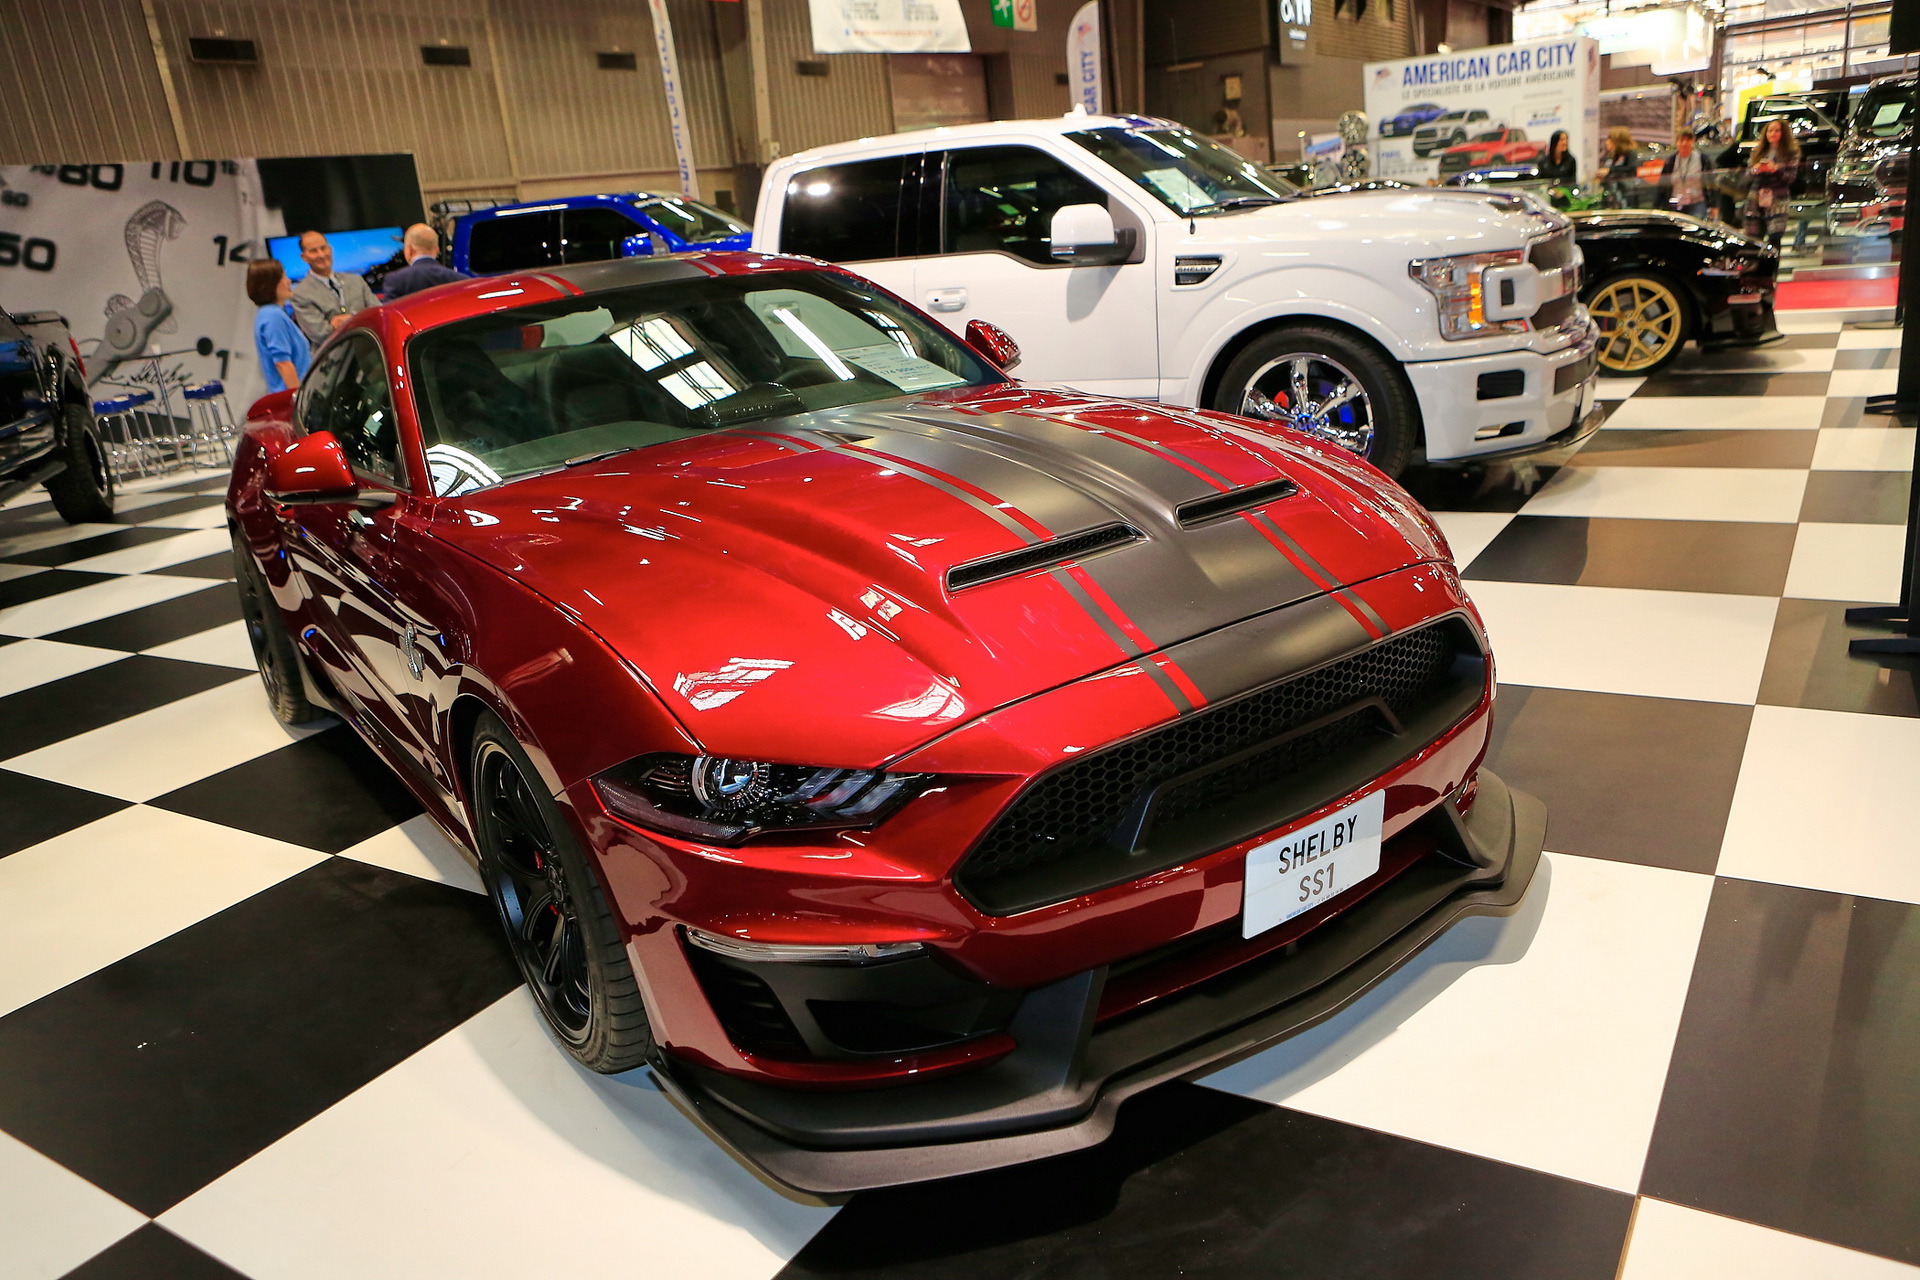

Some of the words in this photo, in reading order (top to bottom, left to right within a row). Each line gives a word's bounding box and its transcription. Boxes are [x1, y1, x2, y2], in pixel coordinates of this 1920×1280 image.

[1081, 51, 1096, 82] CITY
[1403, 57, 1490, 86] AMERICAN
[1497, 50, 1530, 75] CAR
[1537, 42, 1577, 69] CITY
[1083, 86, 1097, 115] CAR
[1279, 814, 1357, 874] SHELBY
[1299, 862, 1335, 902] SS1
